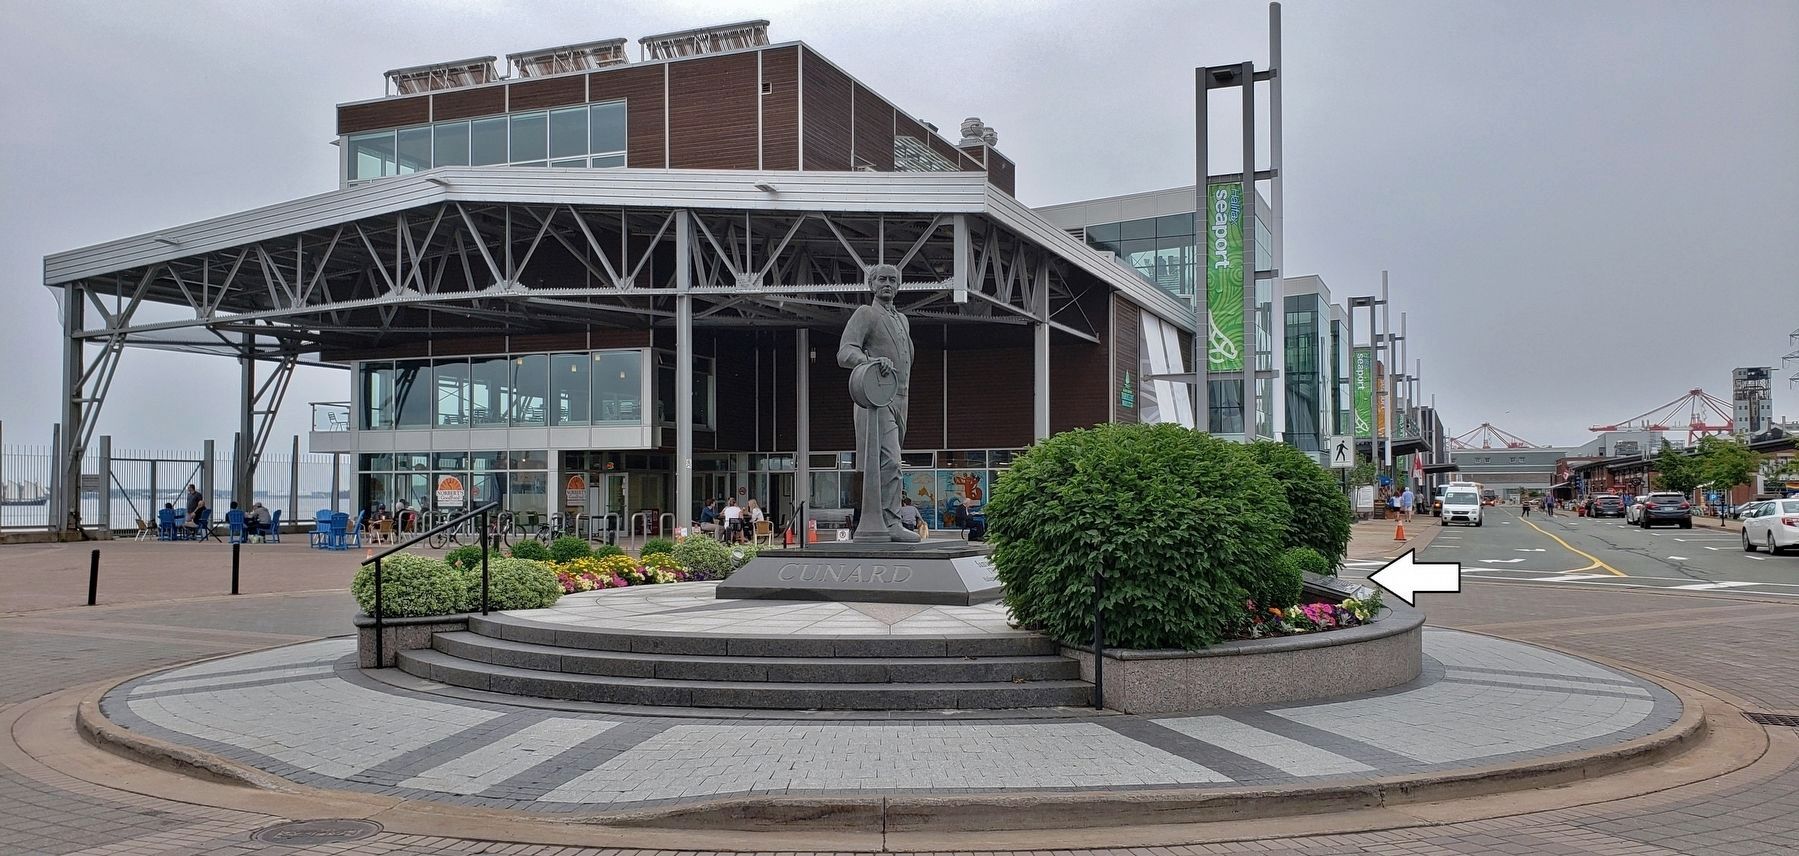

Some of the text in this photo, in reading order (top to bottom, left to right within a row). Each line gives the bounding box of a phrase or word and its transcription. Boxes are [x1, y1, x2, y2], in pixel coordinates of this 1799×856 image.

[1230, 188, 1240, 226] Halifax
[1212, 189, 1230, 269] seaport
[1356, 353, 1365, 390] seaport
[778, 562, 913, 584] CUNARD
